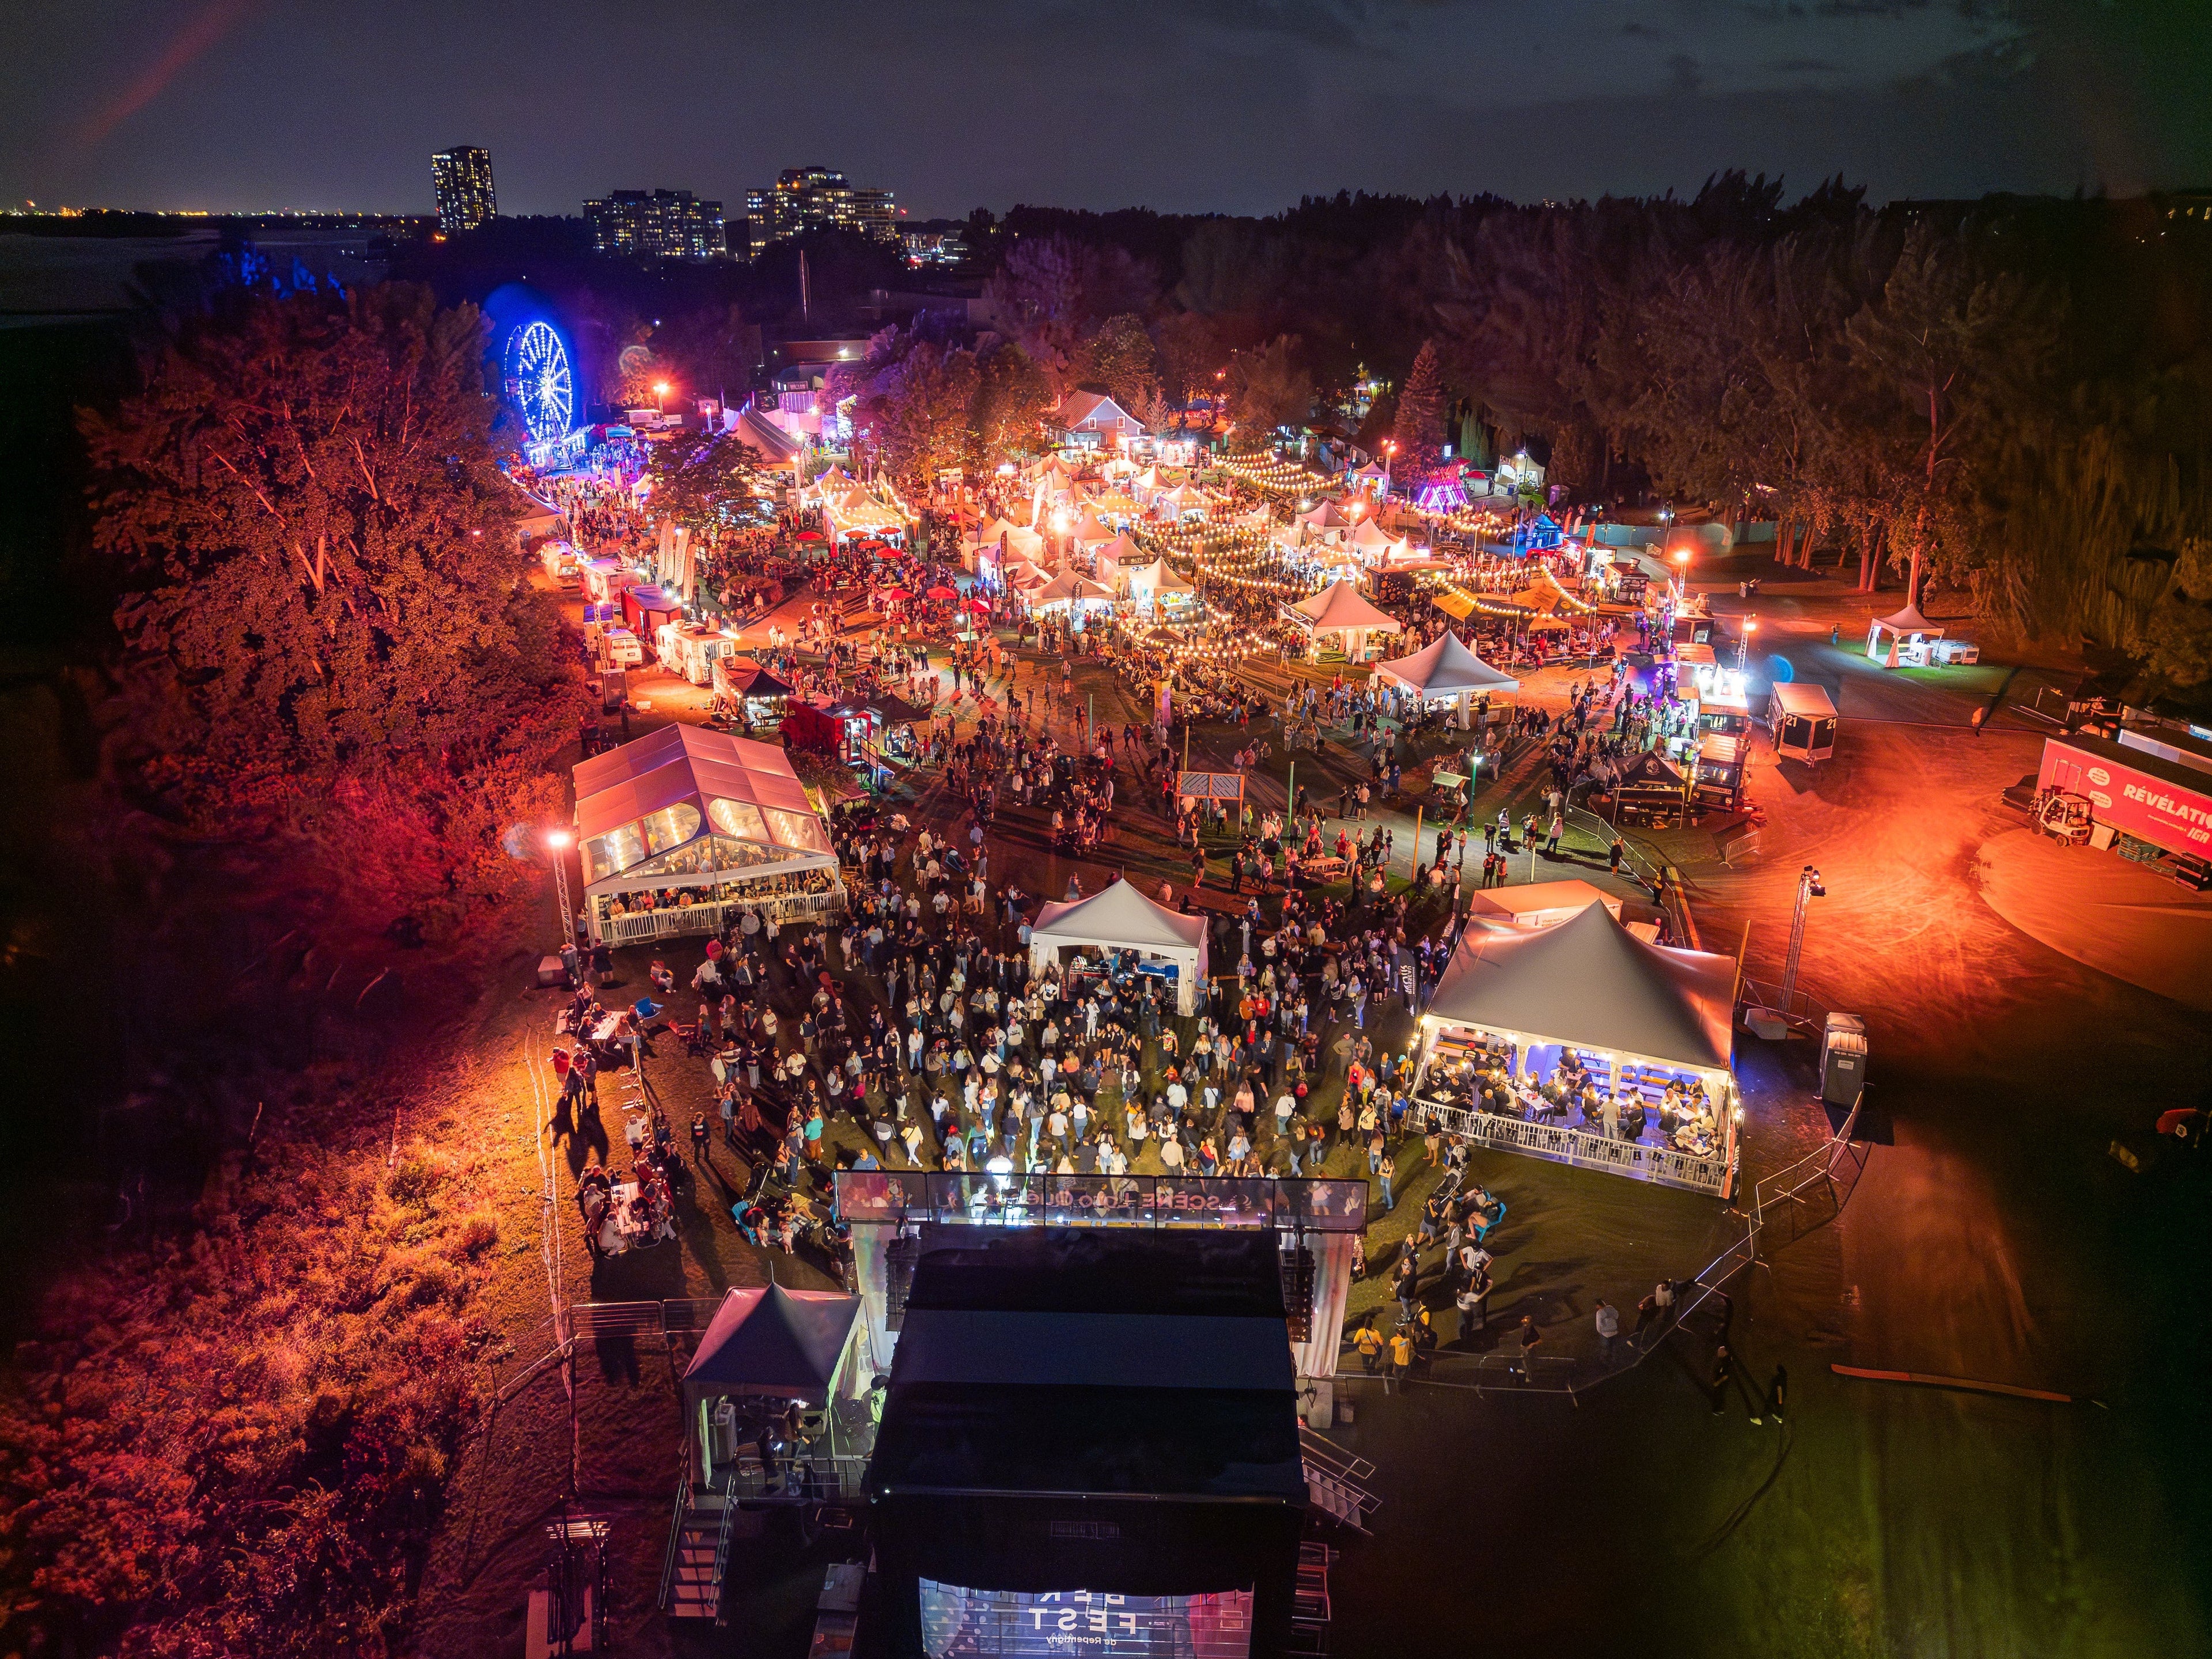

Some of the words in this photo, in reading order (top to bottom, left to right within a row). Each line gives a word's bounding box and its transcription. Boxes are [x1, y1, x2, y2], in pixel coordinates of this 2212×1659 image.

[1786, 714, 1797, 727] 21
[1827, 718, 1837, 729] 21
[2187, 827, 2211, 844] IGA
